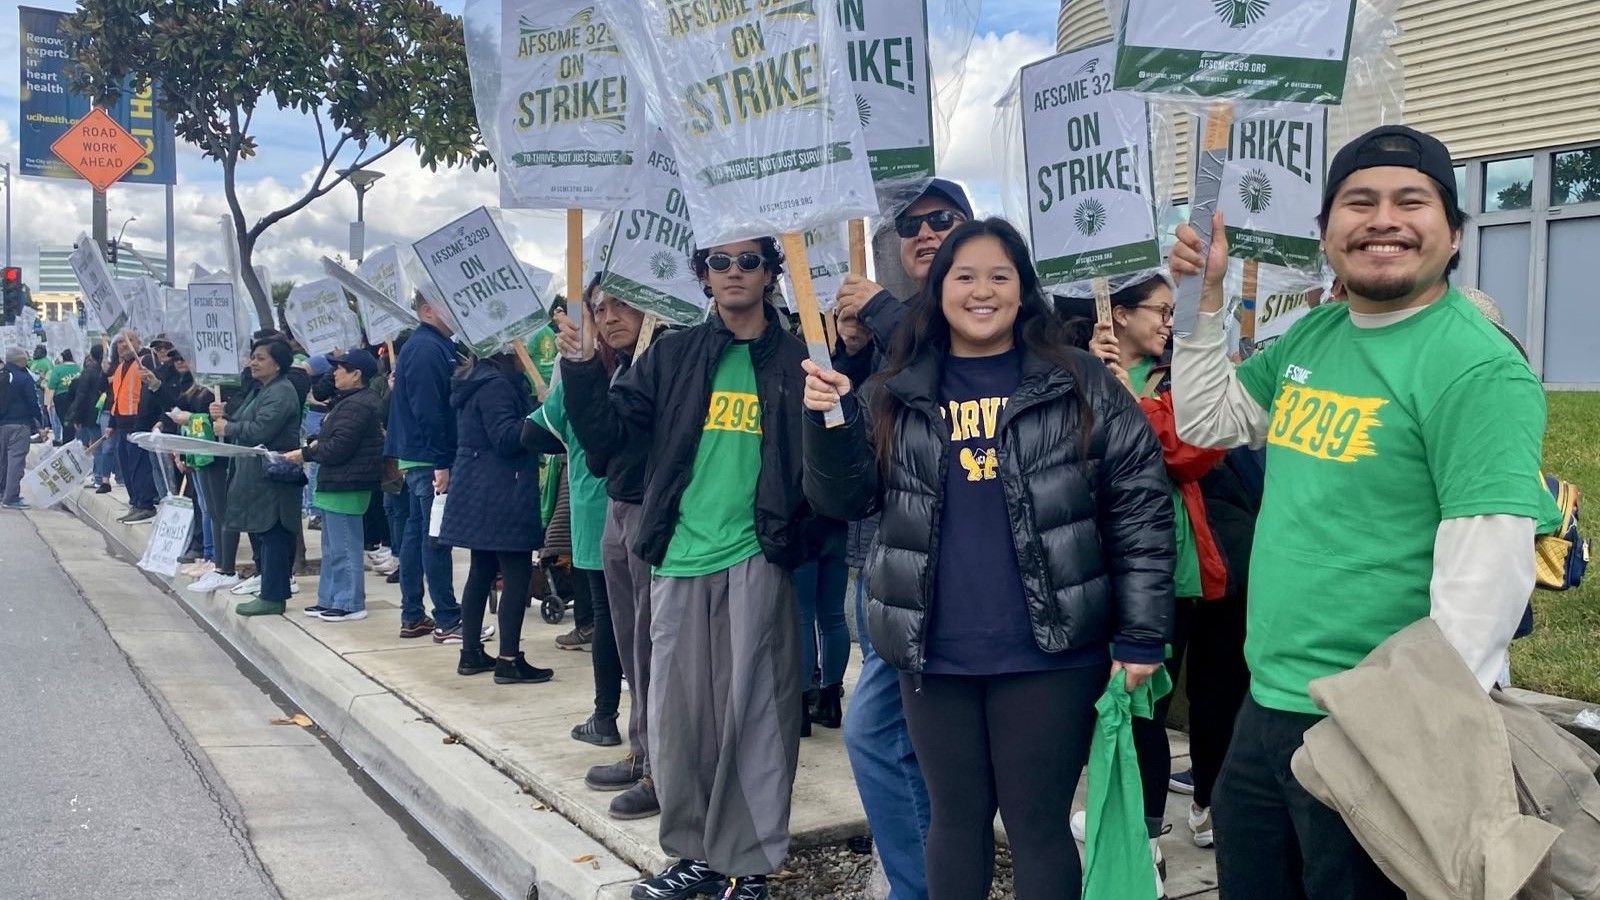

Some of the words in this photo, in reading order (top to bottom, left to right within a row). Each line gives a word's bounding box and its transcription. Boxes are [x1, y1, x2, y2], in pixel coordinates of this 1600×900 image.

[518, 26, 580, 58] AFSCME
[731, 20, 766, 58] ON
[26, 57, 37, 67] in
[26, 69, 58, 81] heart
[560, 53, 584, 79] ON
[1198, 58, 1266, 73] AFSCME3299.ORG
[26, 80, 64, 94] health
[1034, 78, 1088, 112] AFSCME
[518, 75, 628, 128] STRIKE!
[82, 126, 117, 138] ROAD
[1066, 111, 1101, 152] ON
[83, 142, 118, 153] WORK
[523, 153, 531, 163] TO
[558, 153, 572, 163] NOT
[573, 153, 588, 162] JUST
[589, 153, 617, 162] SURVIVE
[80, 157, 123, 168] AHEAD
[647, 150, 679, 177] AFSC
[759, 157, 776, 171] NOT
[777, 153, 798, 169] JUST
[1037, 144, 1141, 213] STRIKE!
[626, 208, 697, 257] STRIK
[430, 239, 467, 267] AFSCME
[464, 226, 491, 247] 3299
[459, 254, 487, 280] ON
[452, 264, 524, 317] STRIKE!
[206, 313, 218, 329] ON
[196, 331, 233, 353] STRIKE!
[949, 396, 1009, 441] IRV
[1274, 389, 1361, 458] 3299
